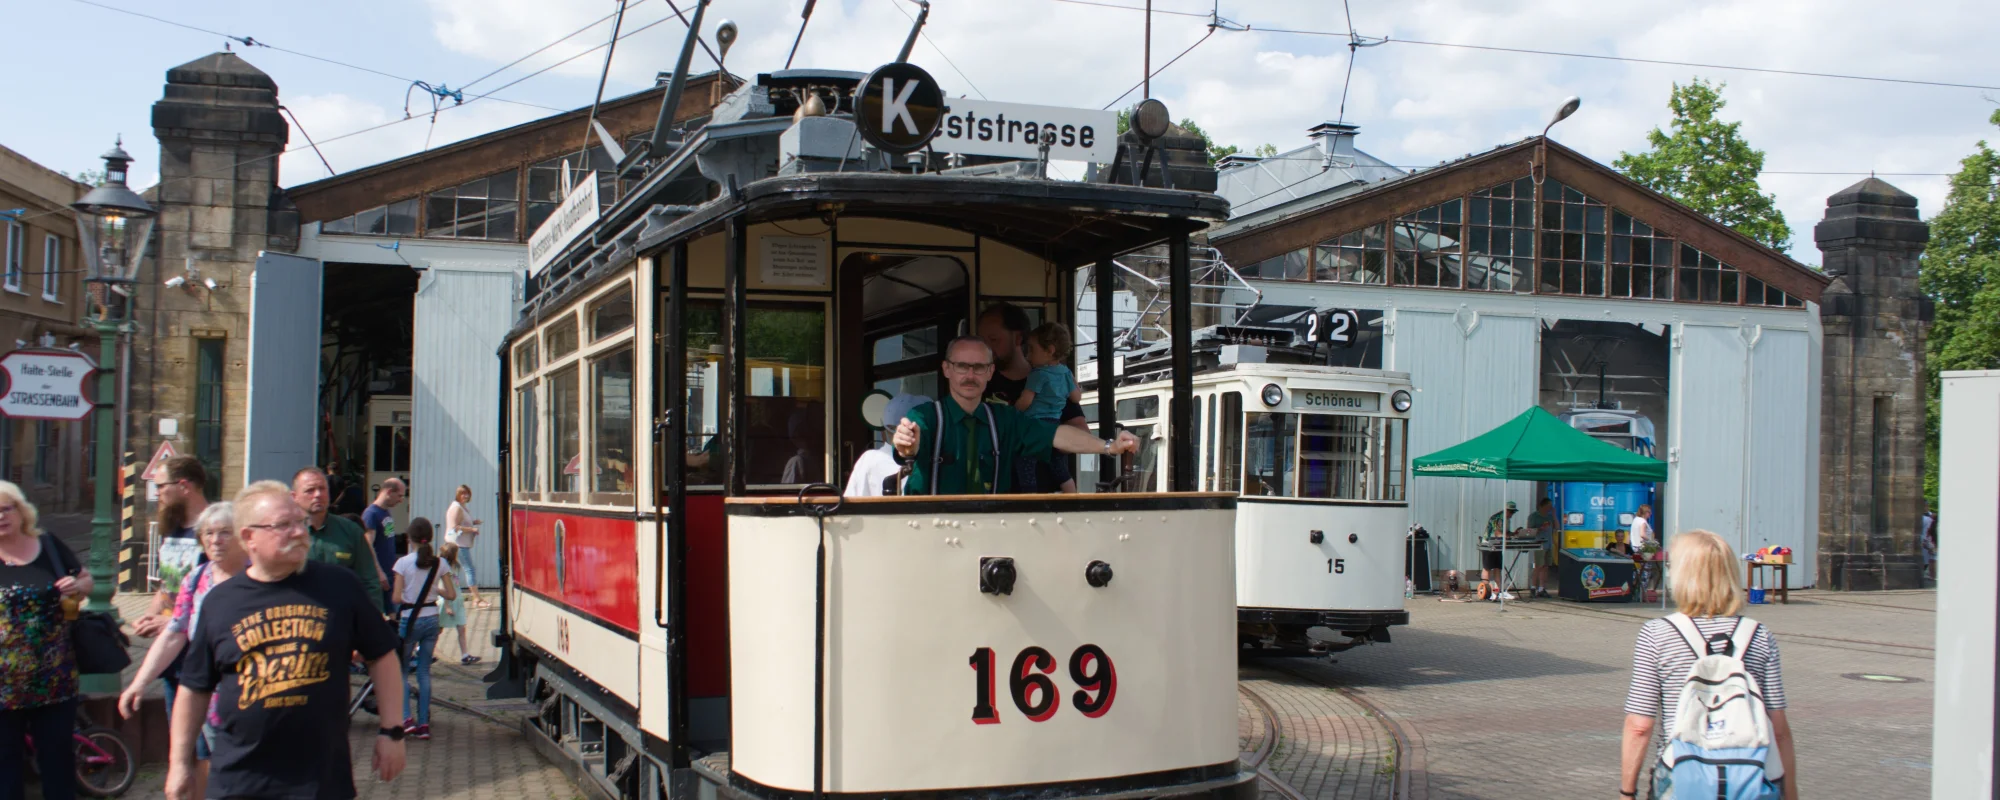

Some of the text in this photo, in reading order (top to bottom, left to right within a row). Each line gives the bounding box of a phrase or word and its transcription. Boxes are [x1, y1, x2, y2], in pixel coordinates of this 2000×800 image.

[881, 77, 920, 135] K
[935, 111, 1095, 149] ststrasse
[1307, 313, 1317, 342] 2
[1330, 312, 1350, 342] 2
[10, 391, 80, 408] STRASSENBAHN
[1305, 392, 1362, 408] Schönau
[1590, 496, 1615, 506] CVAG
[1327, 558, 1345, 574] 15
[236, 618, 326, 652] COLLECTION
[241, 612, 263, 629] THE
[236, 643, 330, 710] Denim
[969, 643, 1118, 725] 169
